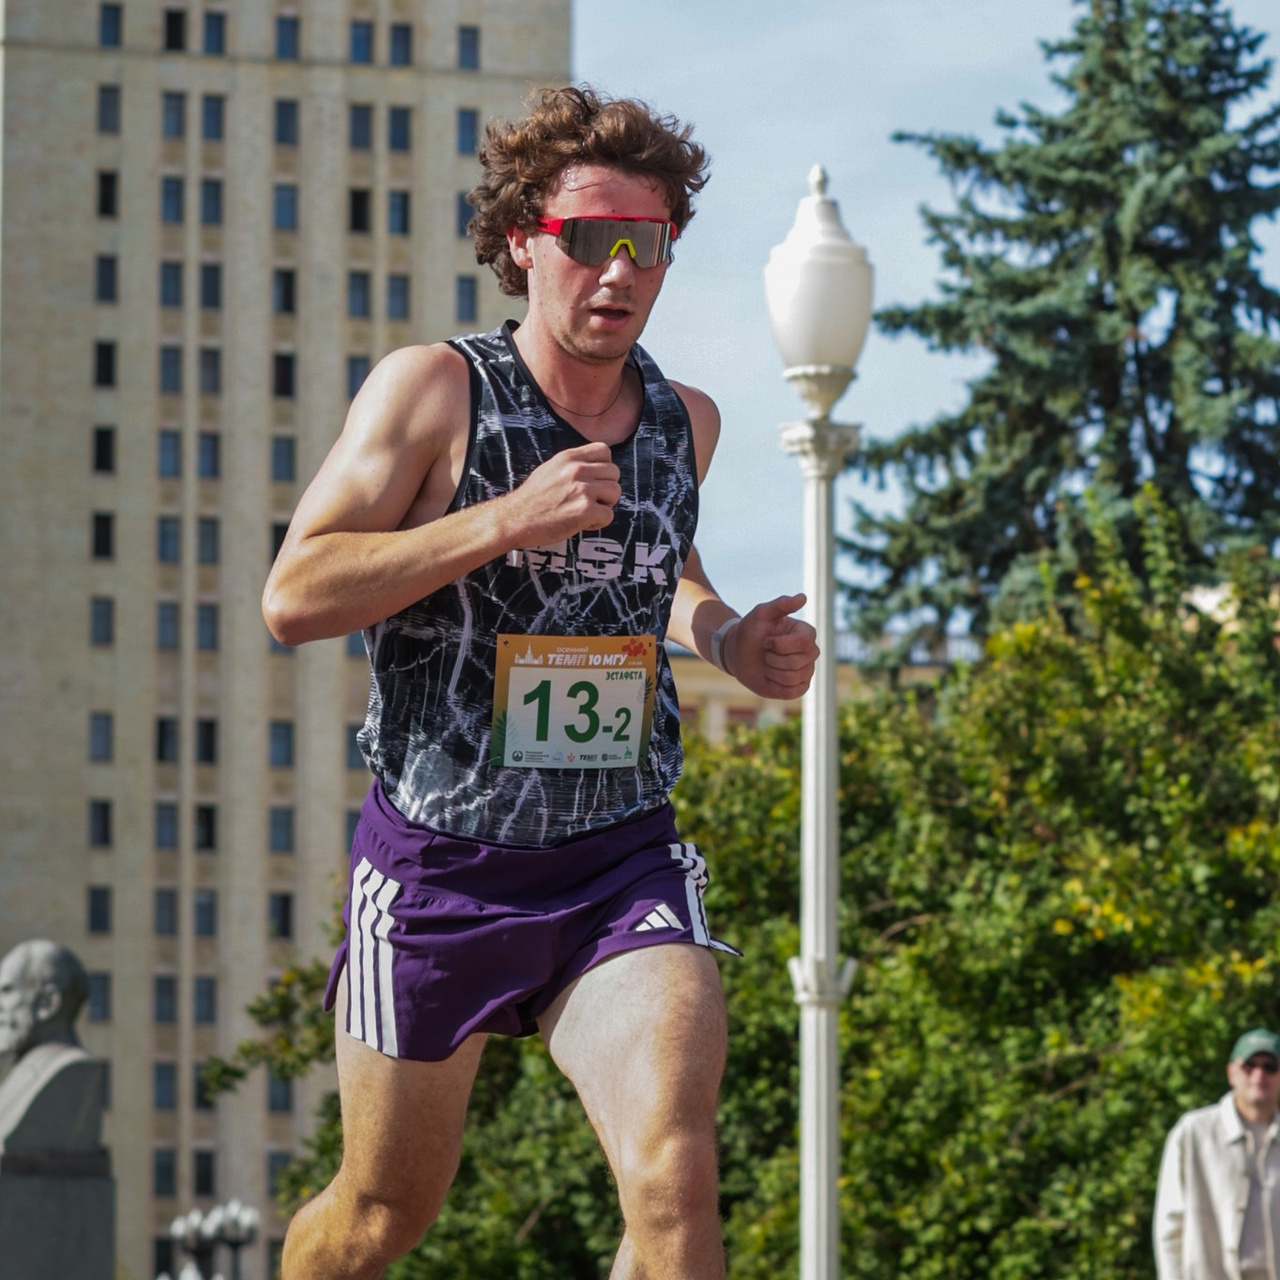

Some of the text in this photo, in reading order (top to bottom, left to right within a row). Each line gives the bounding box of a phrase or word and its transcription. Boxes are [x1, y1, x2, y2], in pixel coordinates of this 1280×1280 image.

[547, 654, 587, 666] ТЕМП
[588, 654, 602, 666] 10
[602, 654, 628, 666] МГУ
[605, 670, 643, 681] ЭСТАФЕТА
[523, 679, 632, 743] 13-2
